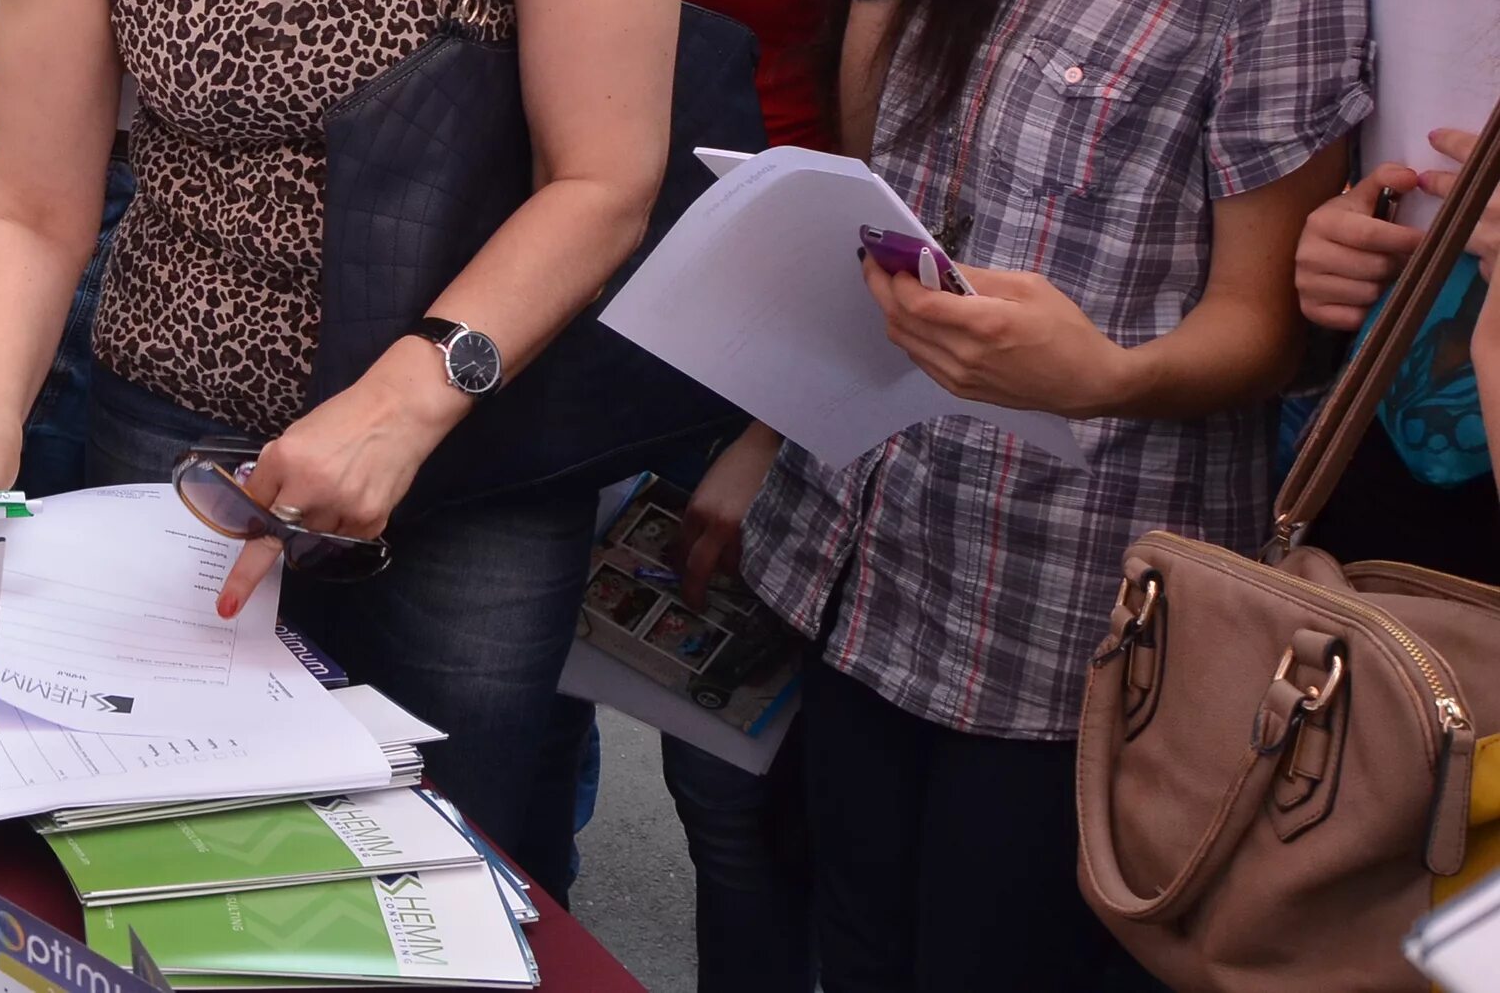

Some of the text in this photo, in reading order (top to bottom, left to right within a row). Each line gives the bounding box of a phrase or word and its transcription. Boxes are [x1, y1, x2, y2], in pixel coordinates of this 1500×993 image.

[324, 811, 372, 859] CONSULTING
[224, 890, 244, 933] SULTING
[384, 894, 414, 965] CONSULTING
